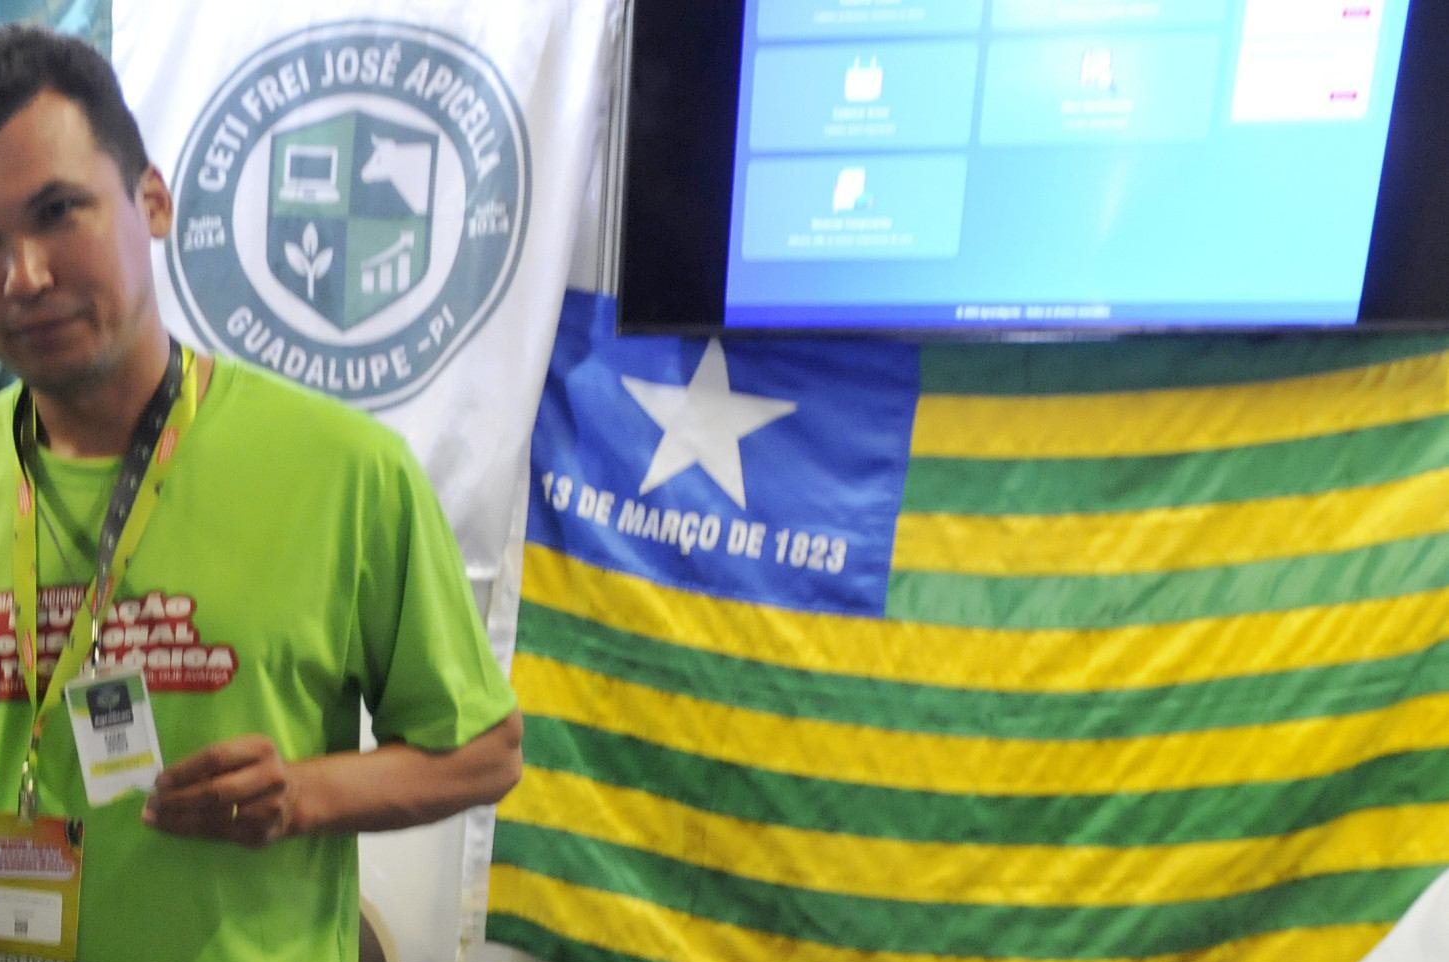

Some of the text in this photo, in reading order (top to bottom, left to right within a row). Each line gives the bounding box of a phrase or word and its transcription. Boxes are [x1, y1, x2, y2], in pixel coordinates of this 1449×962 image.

[197, 41, 502, 192] CETI FREI JOSÉ APICELLA
[226, 305, 412, 391] GUADALUPE
[541, 471, 848, 574] 13 DE MARÇO DE 1823
